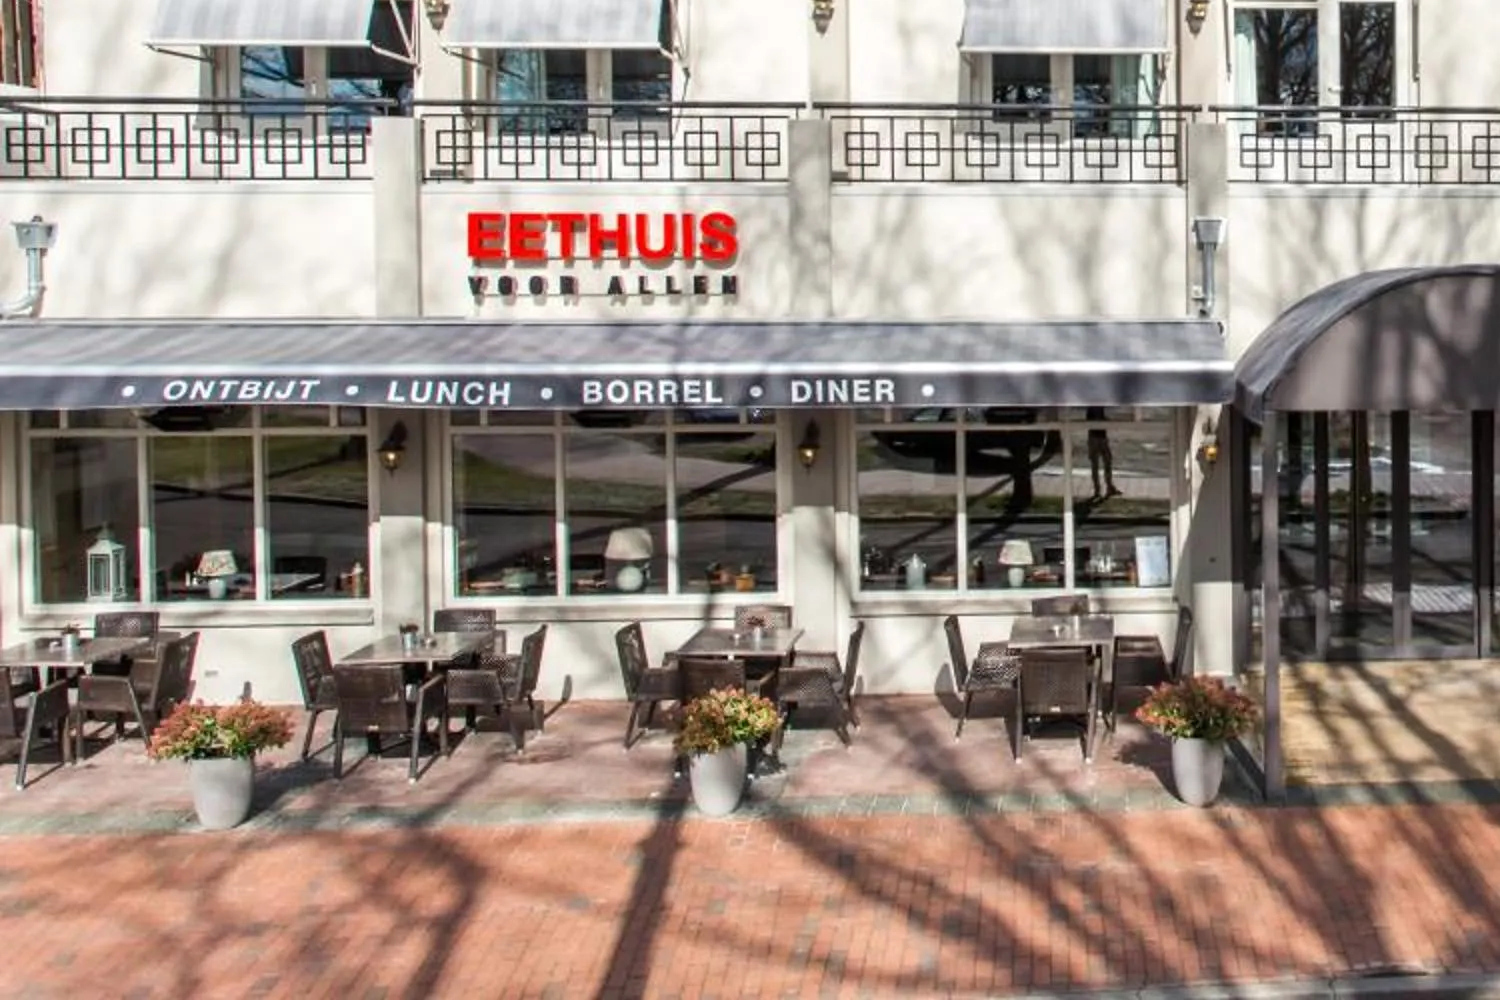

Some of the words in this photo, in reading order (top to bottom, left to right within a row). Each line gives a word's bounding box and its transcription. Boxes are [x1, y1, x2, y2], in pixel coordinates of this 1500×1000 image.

[467, 211, 739, 262] EETHUIS
[467, 275, 580, 297] VOOR
[607, 275, 739, 297] ALLEN
[162, 379, 320, 401] ONTBIJT
[386, 381, 511, 406] LUNCH
[581, 379, 724, 405] BORREL
[789, 378, 896, 404] DINER
